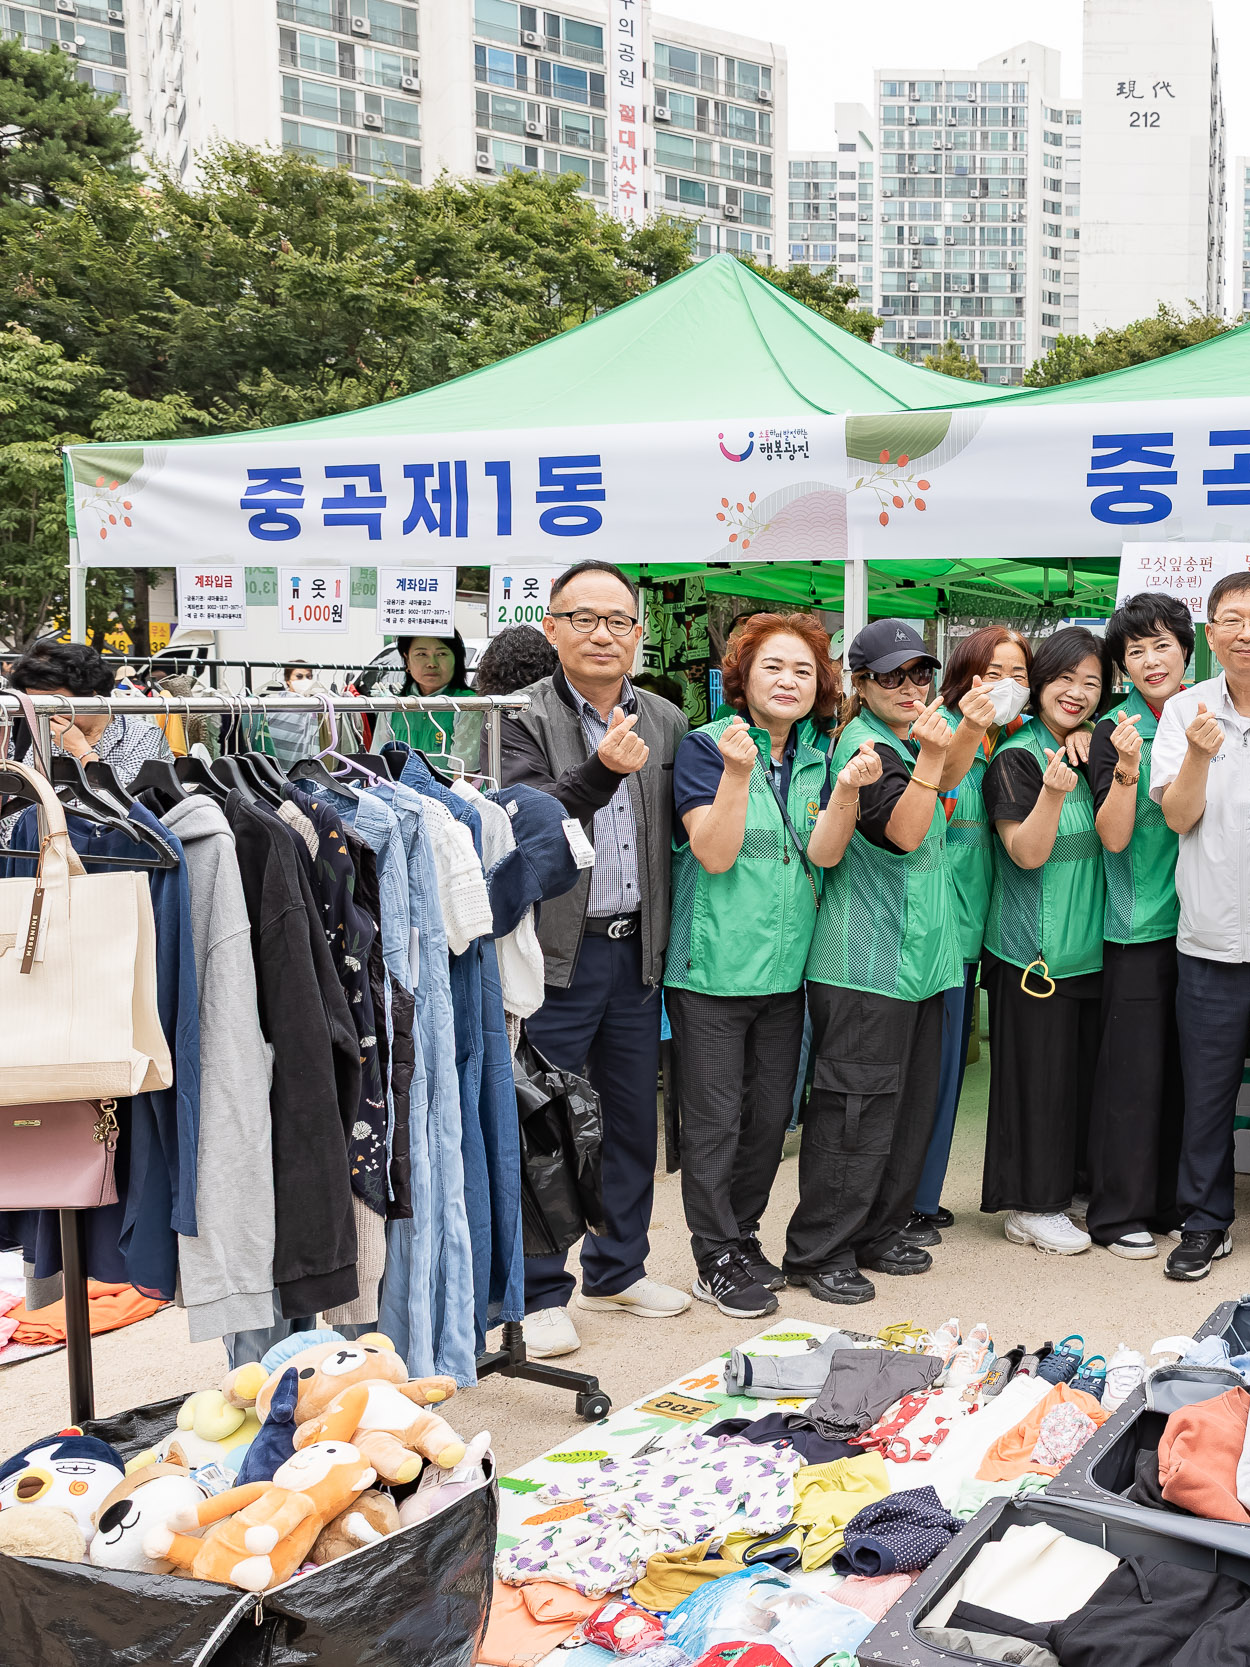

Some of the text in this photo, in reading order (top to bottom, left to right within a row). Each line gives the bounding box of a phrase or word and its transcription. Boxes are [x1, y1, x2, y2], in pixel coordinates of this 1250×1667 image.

[1129, 111, 1161, 127] 212
[759, 440, 809, 461] 행복광진
[240, 454, 606, 541] 중곡제1동
[1137, 555, 1213, 573] 모싯잎송편
[194, 574, 233, 589] 계좌입금
[310, 578, 327, 599] 옷
[395, 577, 439, 592] 계좌입금
[522, 577, 540, 599] 옷
[1145, 575, 1202, 588] (모시송편)
[288, 604, 343, 623] 1,000원
[26, 914, 39, 957] MISSNINE
